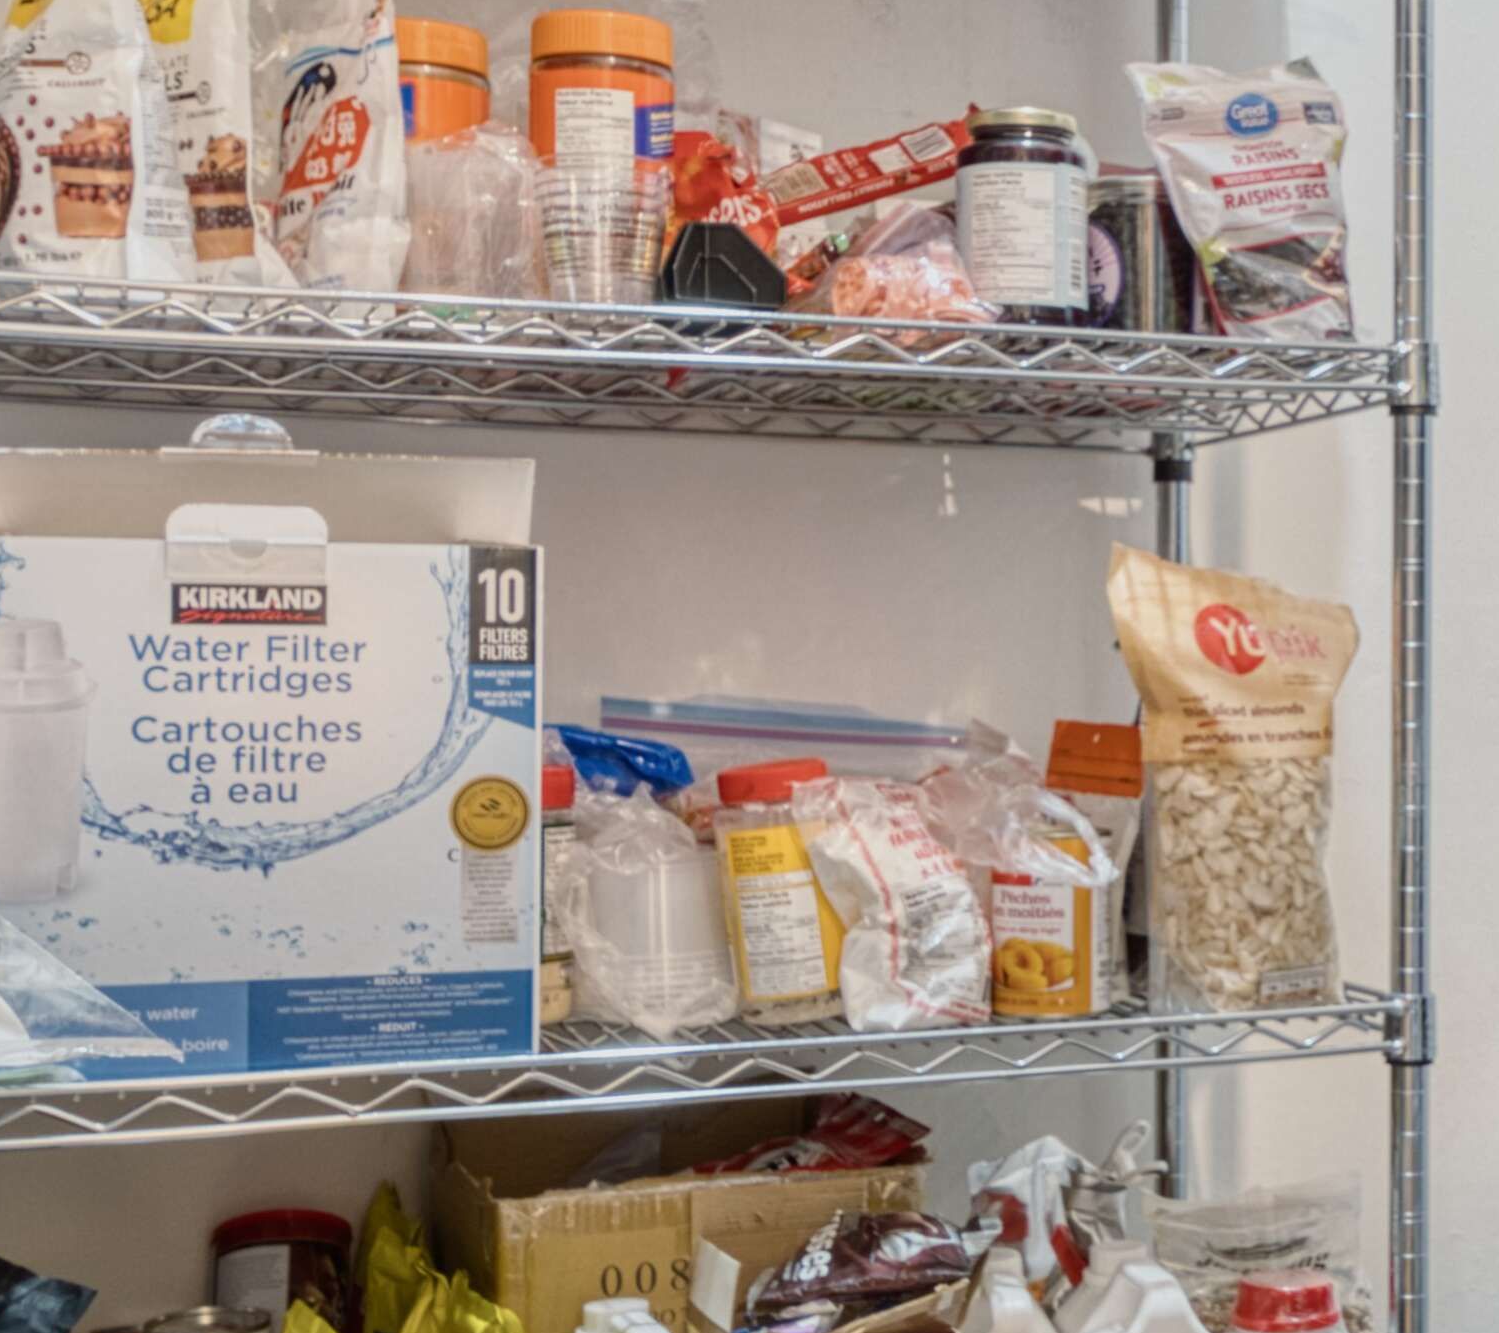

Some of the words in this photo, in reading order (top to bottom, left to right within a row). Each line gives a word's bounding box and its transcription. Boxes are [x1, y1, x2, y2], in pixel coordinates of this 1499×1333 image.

[1231, 103, 1269, 121] Great
[1232, 148, 1299, 166] RAISINS
[1223, 187, 1292, 211] RAISINS
[1295, 183, 1330, 200] SECS
[179, 586, 323, 610] KIRKLAND
[478, 568, 525, 624] 10
[179, 609, 321, 625] Signature
[479, 628, 528, 644] FILTERS
[129, 634, 250, 662] Water
[267, 634, 367, 663] Filter
[479, 644, 528, 661] FILTRES
[143, 664, 352, 698] Cartridges
[132, 714, 362, 743] Cartouches
[167, 746, 217, 773] de
[233, 745, 327, 773] filtre
[190, 775, 211, 804] à
[228, 780, 298, 803] eau
[373, 976, 422, 986] REDUCES
[147, 1007, 199, 1021] water
[181, 1037, 230, 1052] boire
